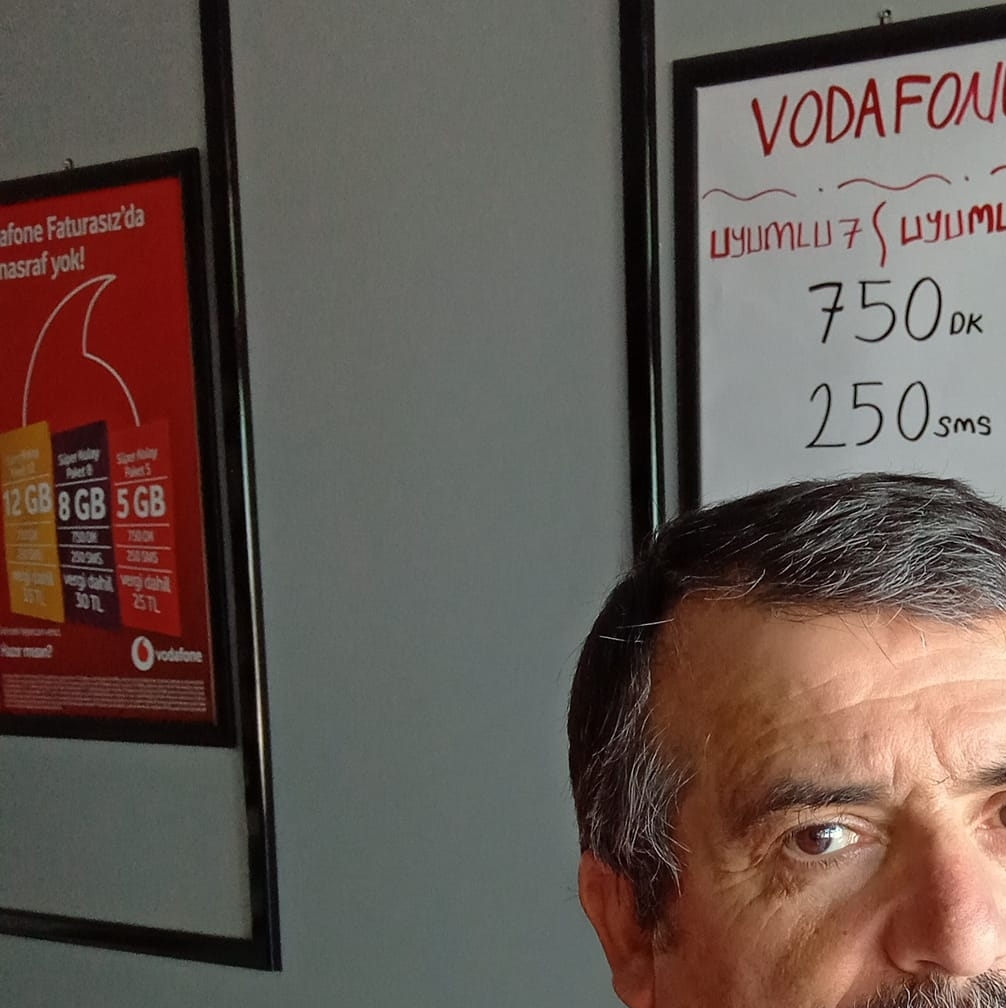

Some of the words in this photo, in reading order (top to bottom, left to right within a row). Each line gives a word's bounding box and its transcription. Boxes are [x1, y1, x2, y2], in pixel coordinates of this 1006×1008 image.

[0, 222, 43, 248] afone
[709, 219, 833, 260] UYUMLU
[51, 246, 85, 280] yok!
[808, 276, 943, 344] 750
[949, 310, 984, 336] DK
[804, 380, 930, 449] 250
[3, 487, 22, 517] 12
[25, 482, 51, 515] GB
[58, 490, 71, 521] 8
[74, 487, 107, 521] GB
[116, 488, 130, 519] 5
[134, 485, 166, 519] GB
[155, 647, 203, 663] vodafone
